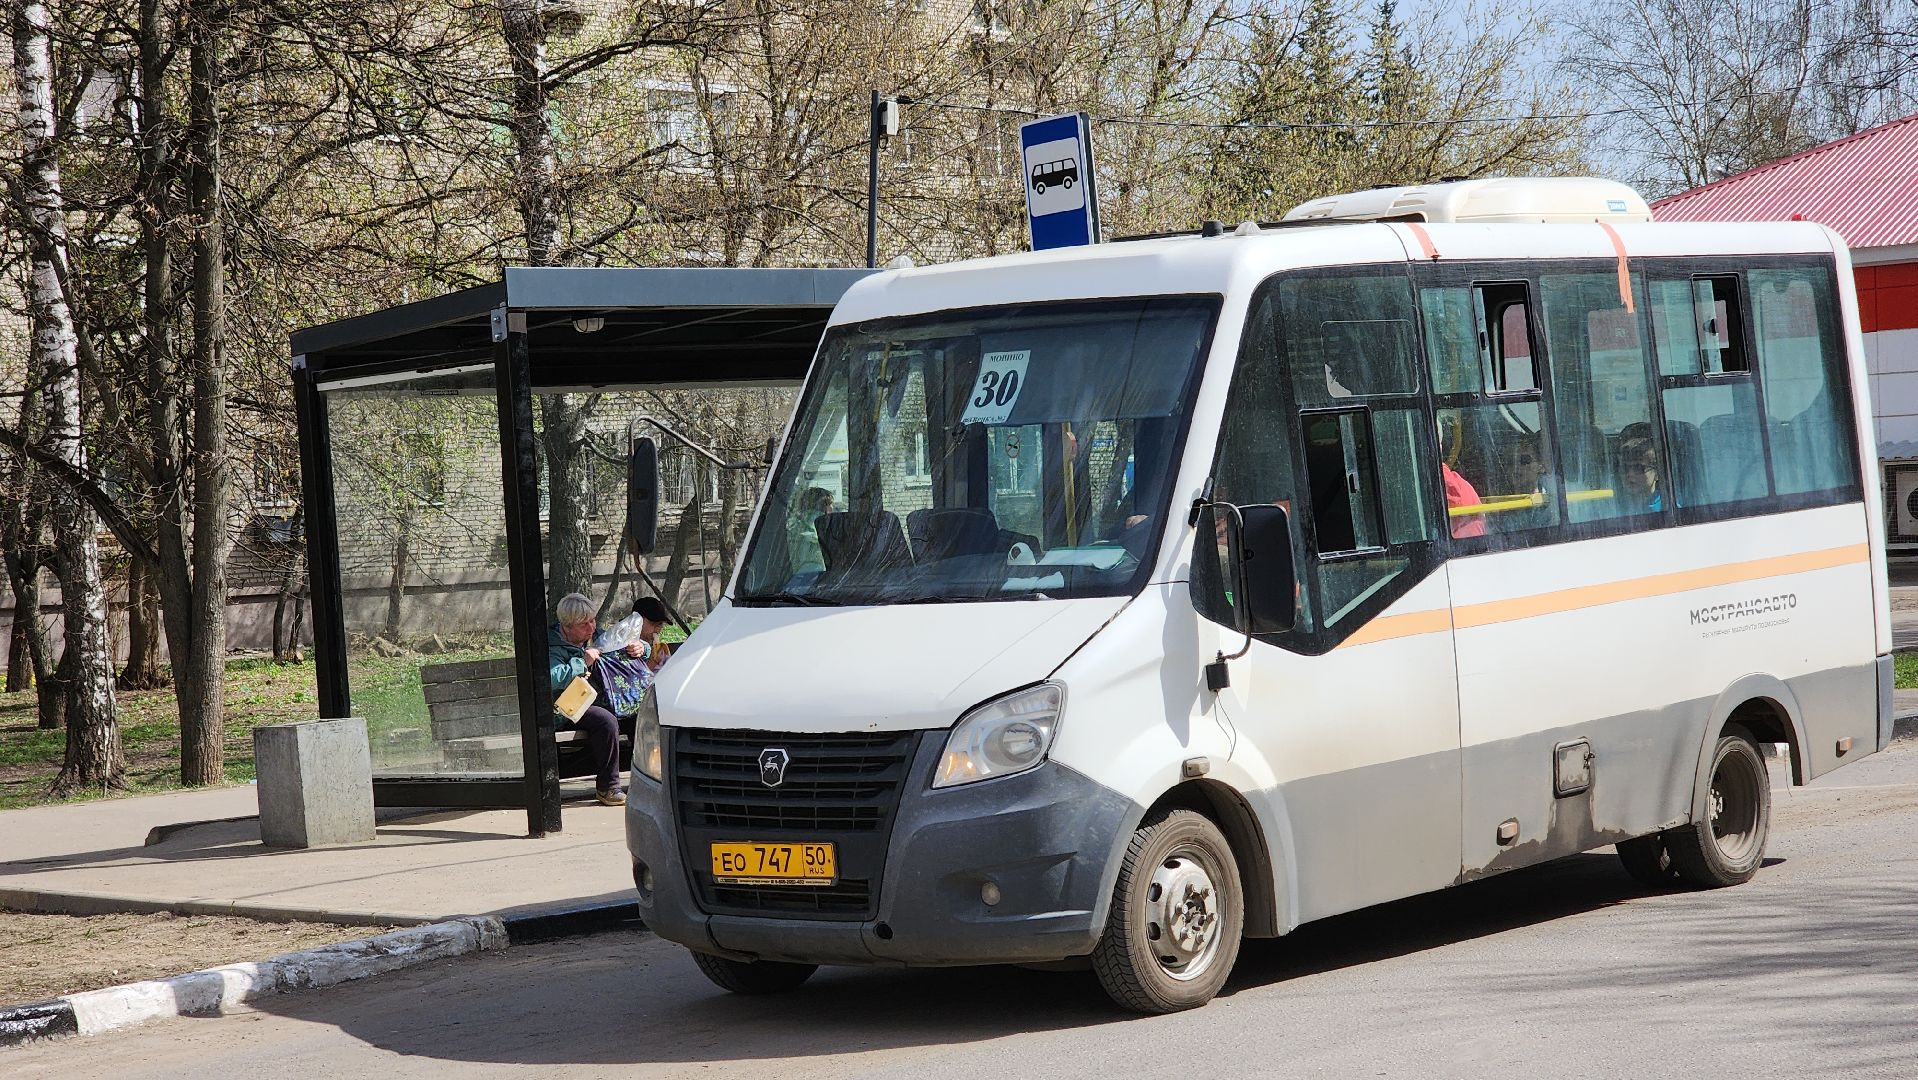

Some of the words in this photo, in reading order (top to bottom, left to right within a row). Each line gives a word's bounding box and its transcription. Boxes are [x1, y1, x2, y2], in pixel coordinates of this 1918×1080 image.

[973, 369, 1019, 408] 30
[1690, 593, 1797, 625] МОСТРАНСАВТО
[754, 847, 792, 872] 747
[805, 846, 826, 865] 50
[809, 867, 825, 875] RUS
